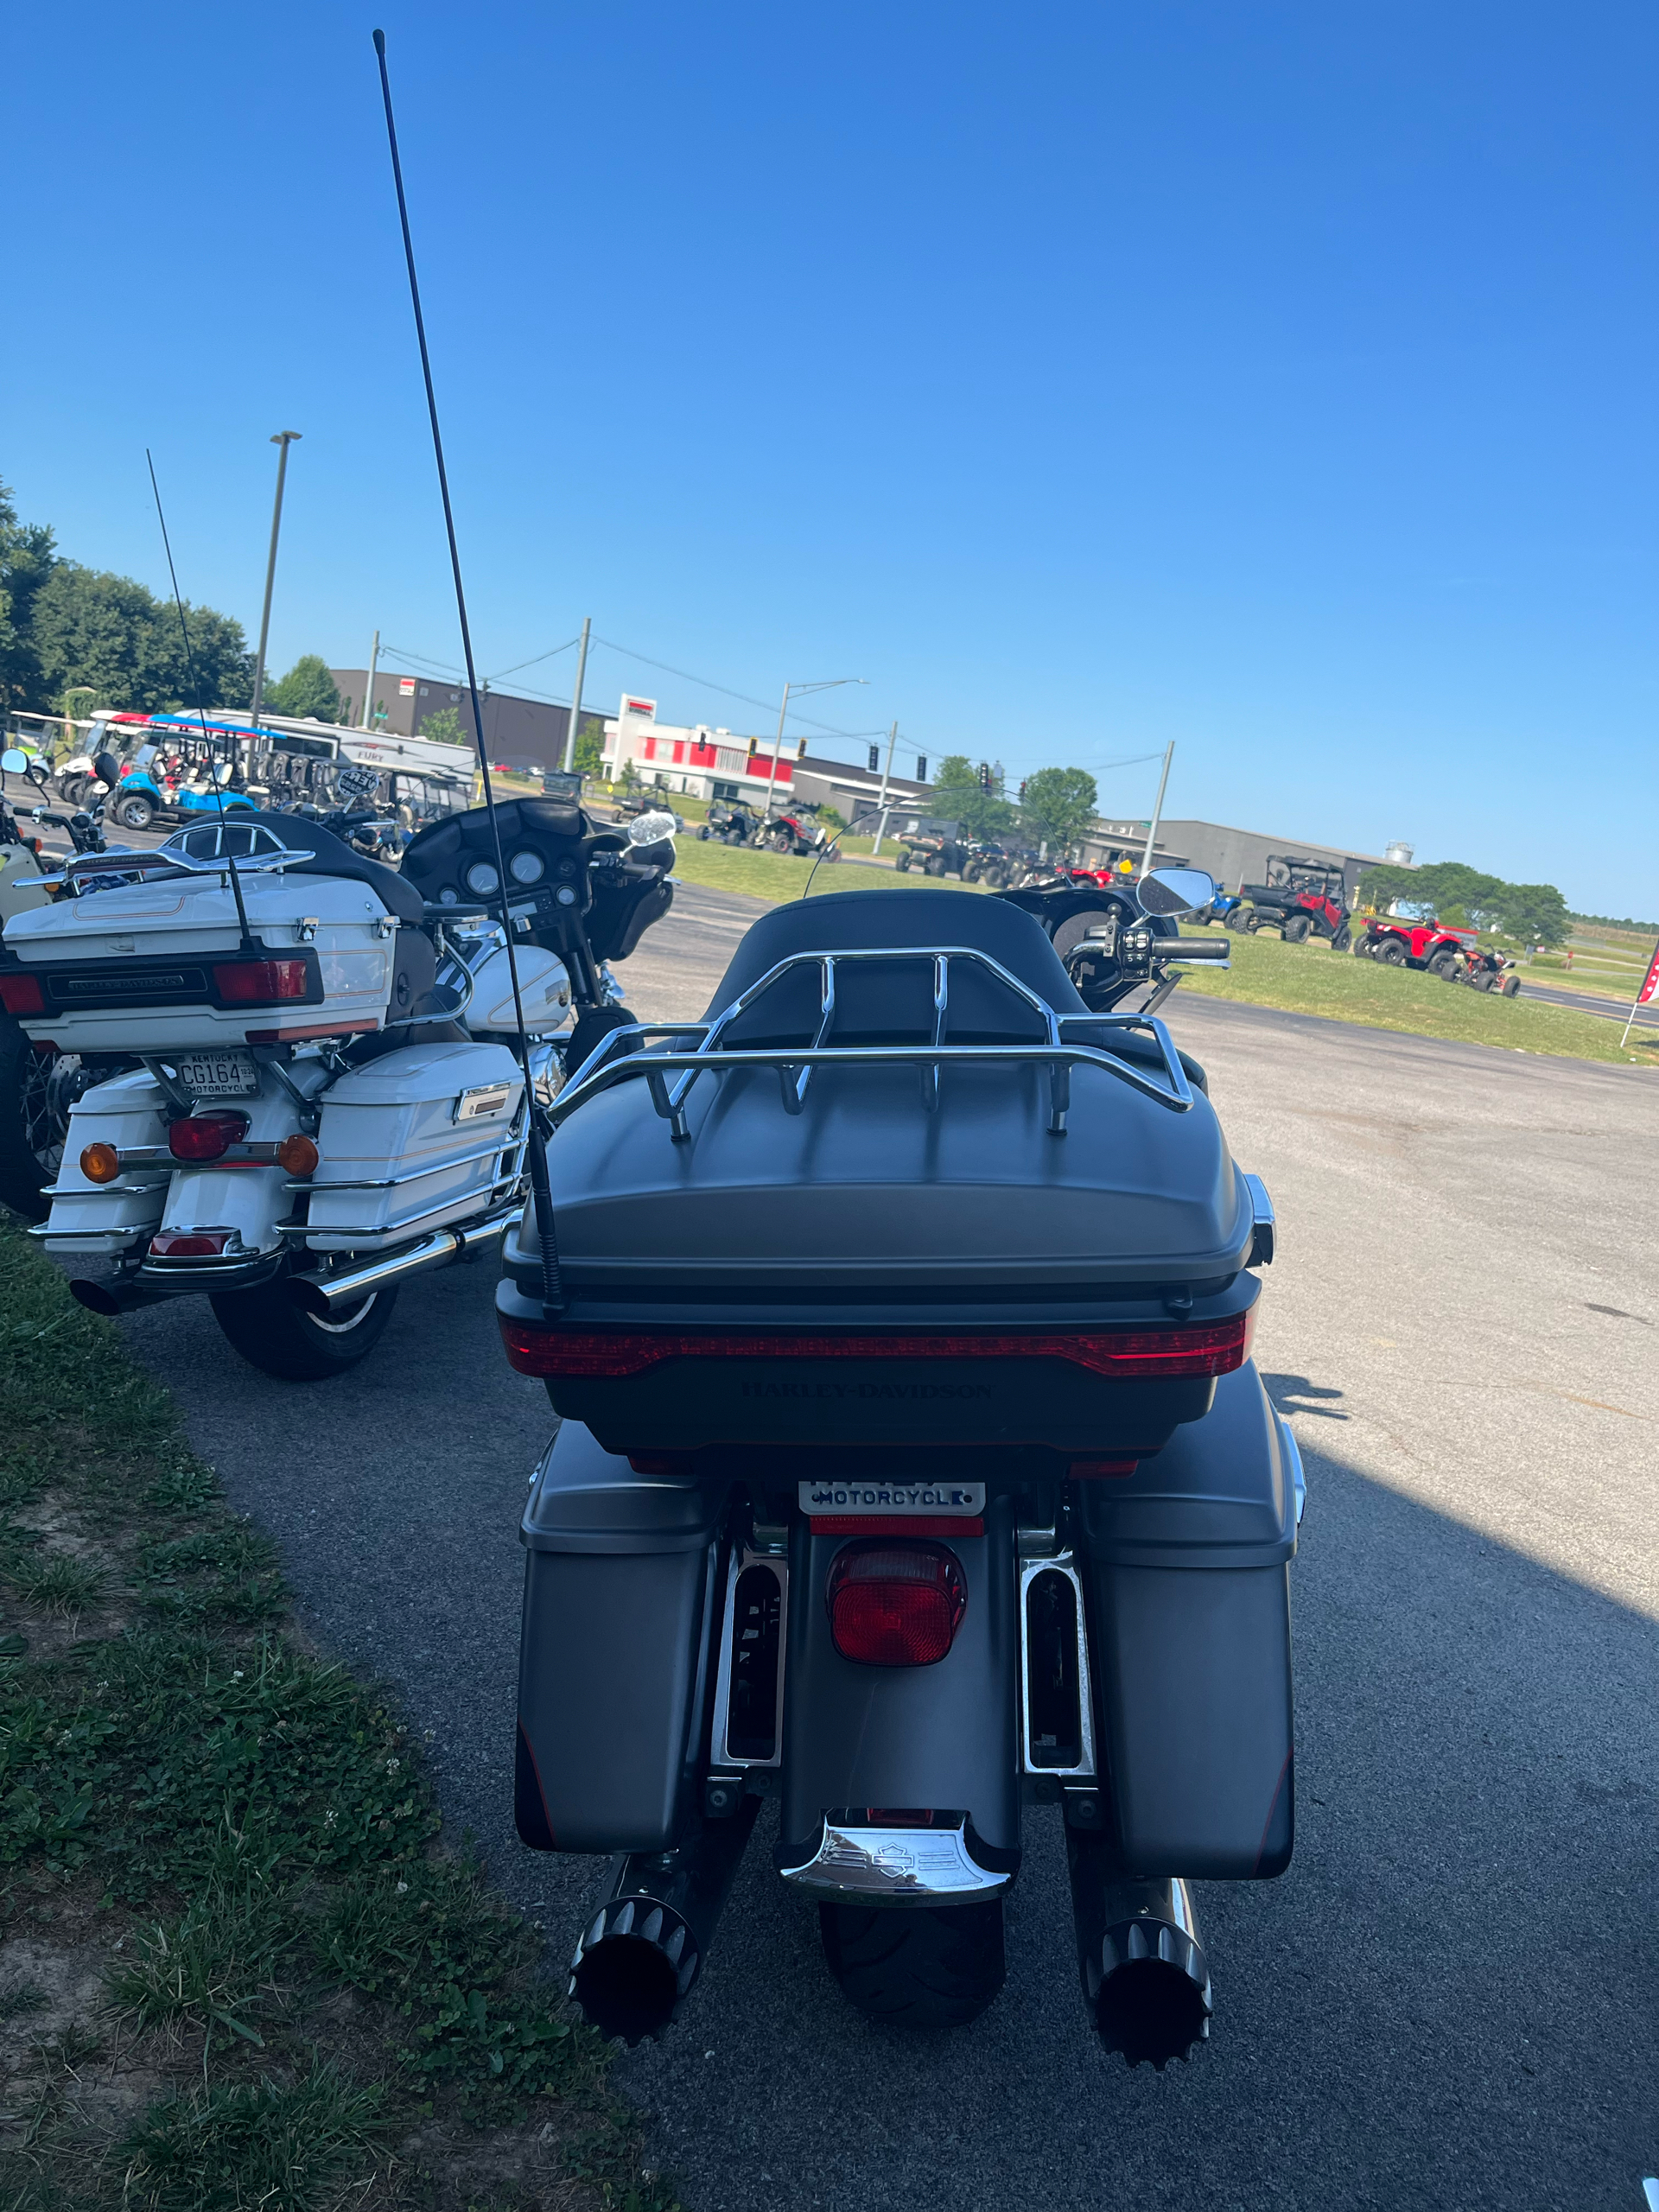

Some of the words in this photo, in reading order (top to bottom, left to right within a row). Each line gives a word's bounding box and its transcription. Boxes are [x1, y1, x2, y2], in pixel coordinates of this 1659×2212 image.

[358, 751, 384, 762] FURY
[192, 1054, 238, 1063] KENTUCKY
[181, 1064, 240, 1084] CG164
[741, 1382, 993, 1399] HARLEY-DAVIDSON
[820, 1491, 963, 1505] MOTORCYCLE
